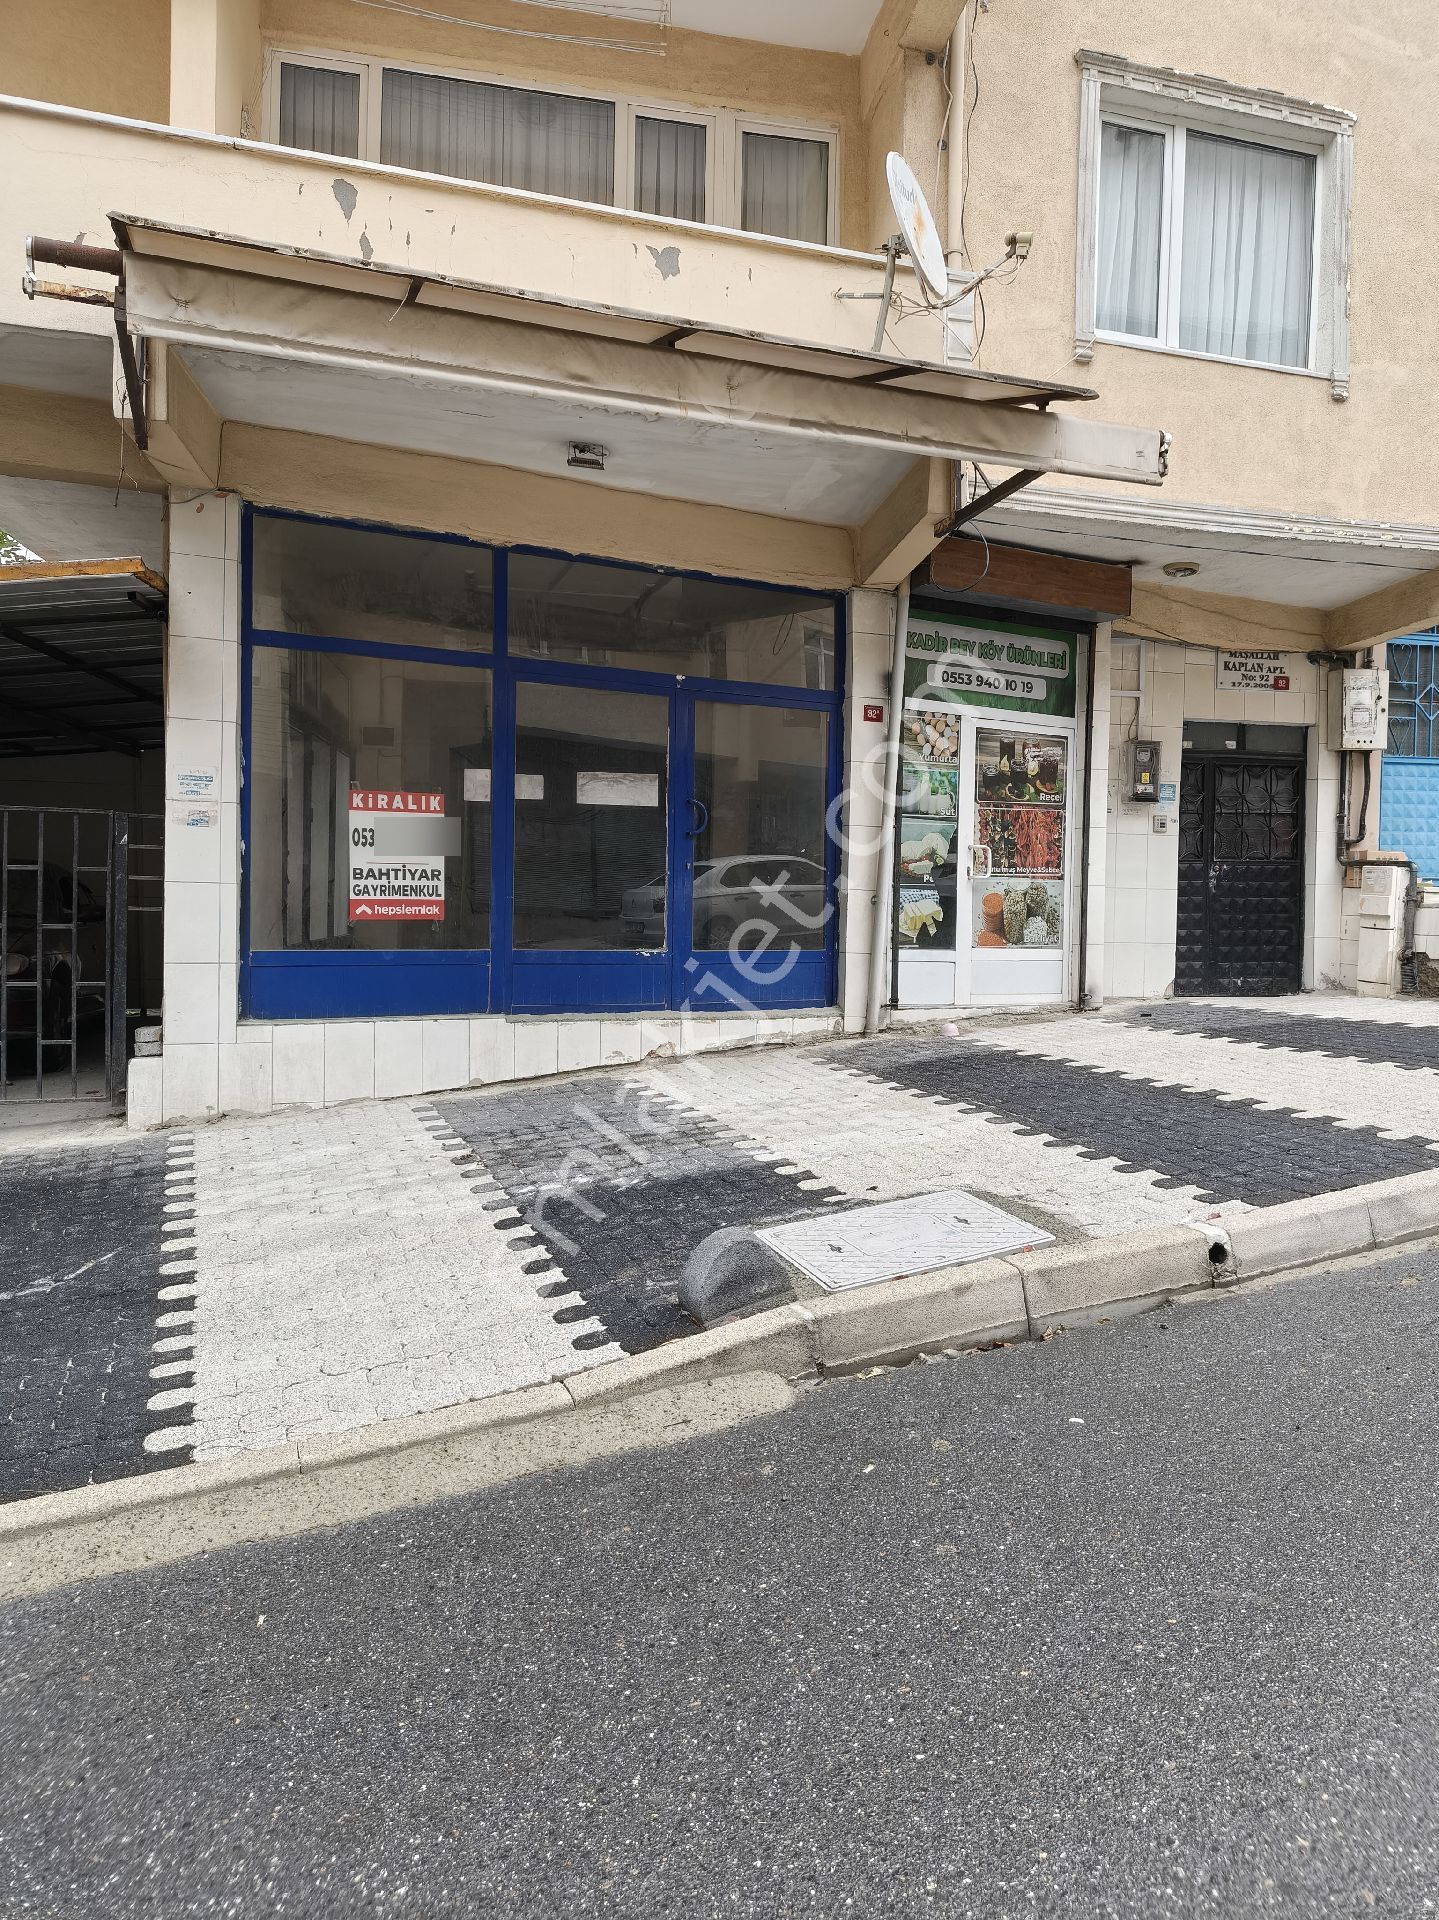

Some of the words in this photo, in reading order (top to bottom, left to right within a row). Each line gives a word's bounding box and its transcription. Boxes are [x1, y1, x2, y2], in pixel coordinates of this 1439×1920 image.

[906, 631, 948, 653] KADİR
[950, 638, 976, 657] BEY
[978, 640, 1005, 661] KÖY
[1007, 643, 1067, 670] ÜRÜNLERİ
[1223, 660, 1264, 673] KAPLAN
[941, 671, 973, 686] 0553
[975, 676, 1001, 690] 940
[1005, 679, 1017, 692] 10
[1021, 681, 1034, 694] 19
[1241, 673, 1256, 682] No:
[1259, 674, 1270, 682] 92
[918, 753, 958, 763] Yumurta
[352, 864, 442, 881] BAHTİYAR
[352, 880, 442, 897] GAYRİMENKUL
[374, 904, 440, 916] hepsiemlak
